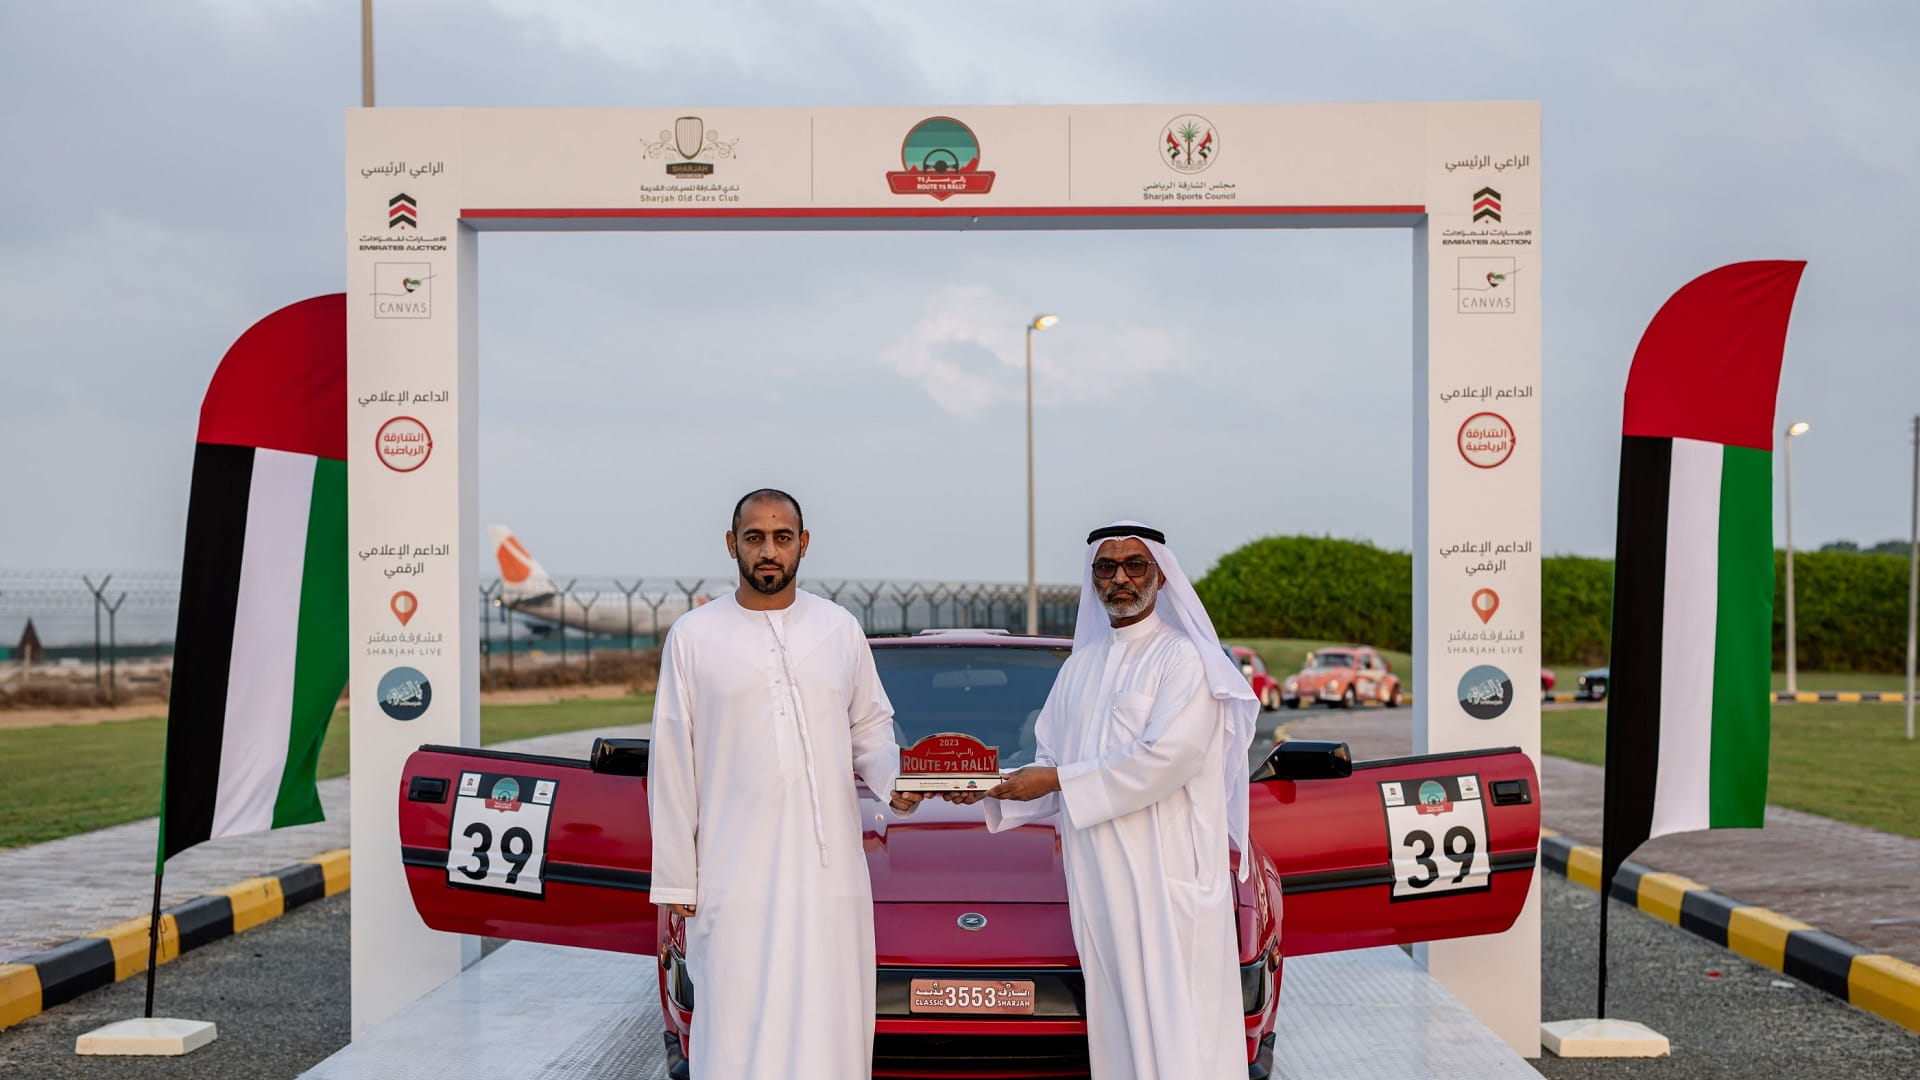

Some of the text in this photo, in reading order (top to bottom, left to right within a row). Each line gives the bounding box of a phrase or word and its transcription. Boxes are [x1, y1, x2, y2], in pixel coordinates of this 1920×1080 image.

[1445, 155, 1529, 172] الراعي الرئيسي
[361, 162, 444, 178] الراعي الرئيسي
[640, 184, 664, 192] القديمة
[666, 184, 696, 192] للسيارات
[696, 184, 722, 192] الشارقة
[1143, 181, 1236, 191] مجلس الشارقة الرياضي
[640, 194, 739, 203] Sharjah Old Cars Club
[1144, 192, 1236, 202] Sharjah Sports Council
[379, 302, 427, 313] CANVAS
[1463, 298, 1510, 308] CANVAS
[358, 390, 449, 407] الداعم الإعلامي
[1440, 386, 1532, 404] الداعم الإعلامي
[384, 433, 424, 444] الشارقة
[1466, 429, 1506, 440] الشارقة
[384, 445, 424, 456] الرياضية
[1466, 442, 1506, 452] الرياضية
[358, 544, 449, 560] الداعم الإعلامي
[1440, 541, 1532, 558] الداعم الإعلامي
[384, 563, 424, 578] الرقمي
[1465, 560, 1506, 576] الرقمي
[367, 632, 442, 644] الشارقة مباشر
[1448, 630, 1524, 642] الشارقة مباشر
[366, 648, 442, 657] SHARJAH LIVE
[1448, 646, 1524, 655] SHARJAH LIVE
[925, 748, 974, 758] رالي مسار
[903, 755, 996, 771] ROUTE 71 RALLY
[457, 822, 533, 884] 39
[1403, 826, 1476, 888] 39
[945, 986, 996, 1007] 3553
[998, 987, 1029, 997] الشارقة
